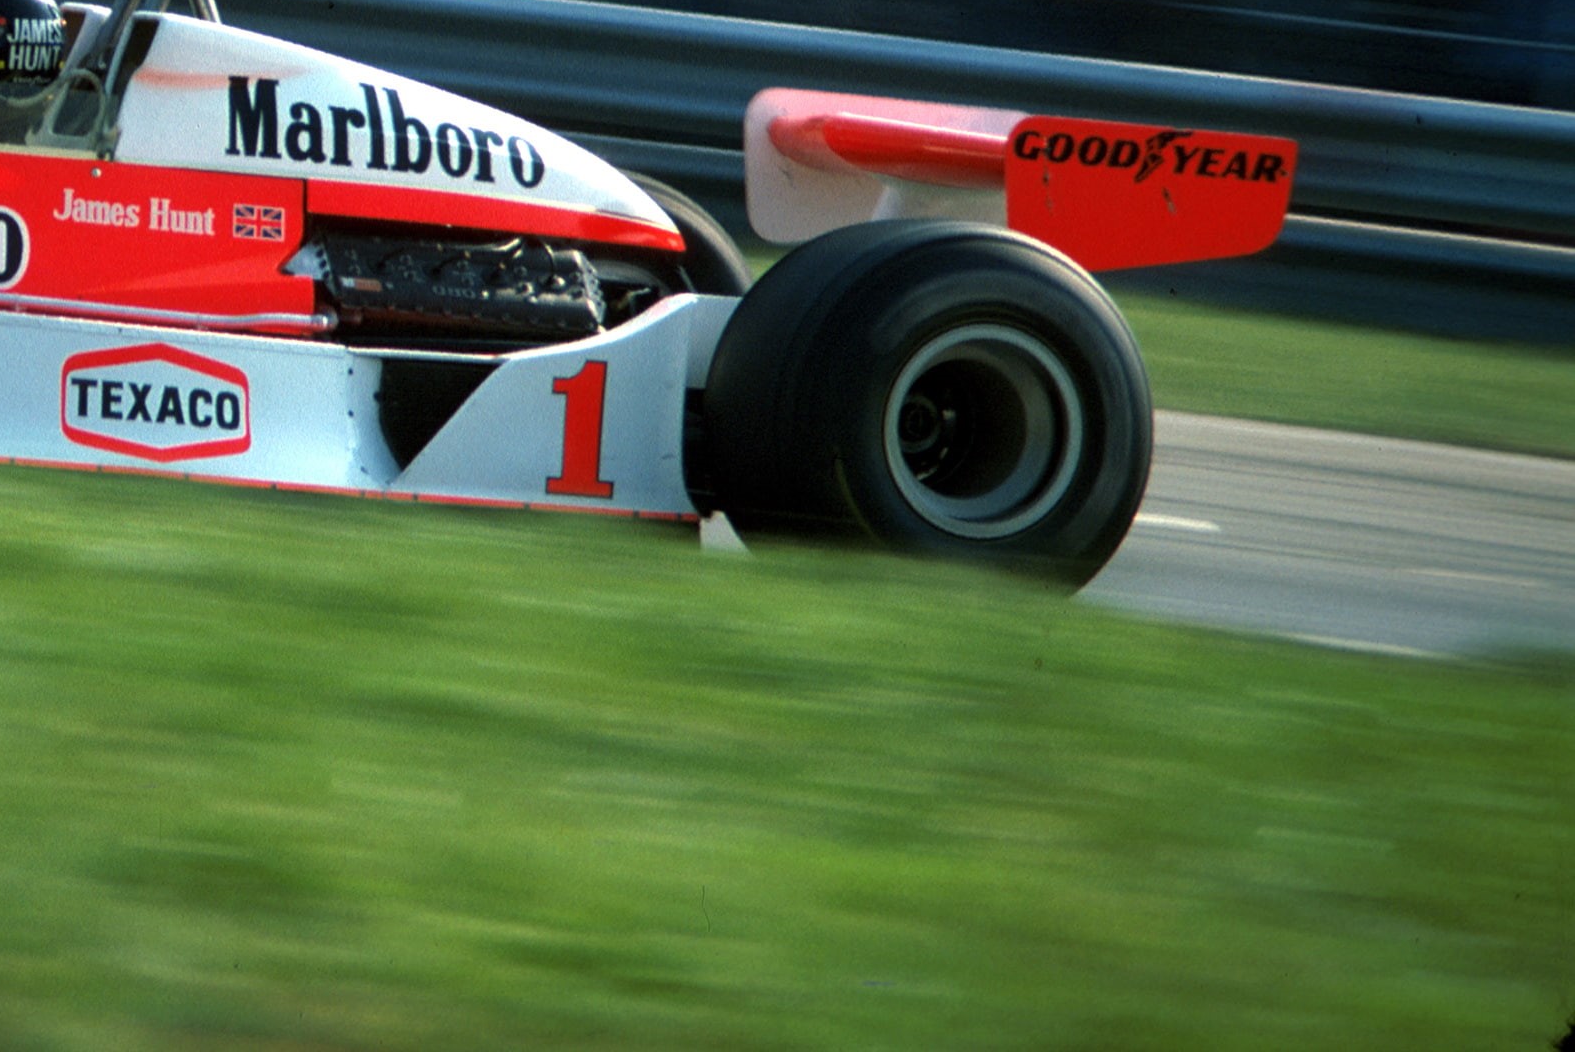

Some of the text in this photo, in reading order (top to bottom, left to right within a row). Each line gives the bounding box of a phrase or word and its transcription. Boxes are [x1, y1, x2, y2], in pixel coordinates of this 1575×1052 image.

[6, 17, 63, 44] JAMES
[8, 44, 62, 71] HUNT
[225, 75, 545, 189] Marlboro
[53, 187, 216, 237] James Hunt
[70, 377, 241, 431] TEXACO
[545, 360, 615, 500] 1
